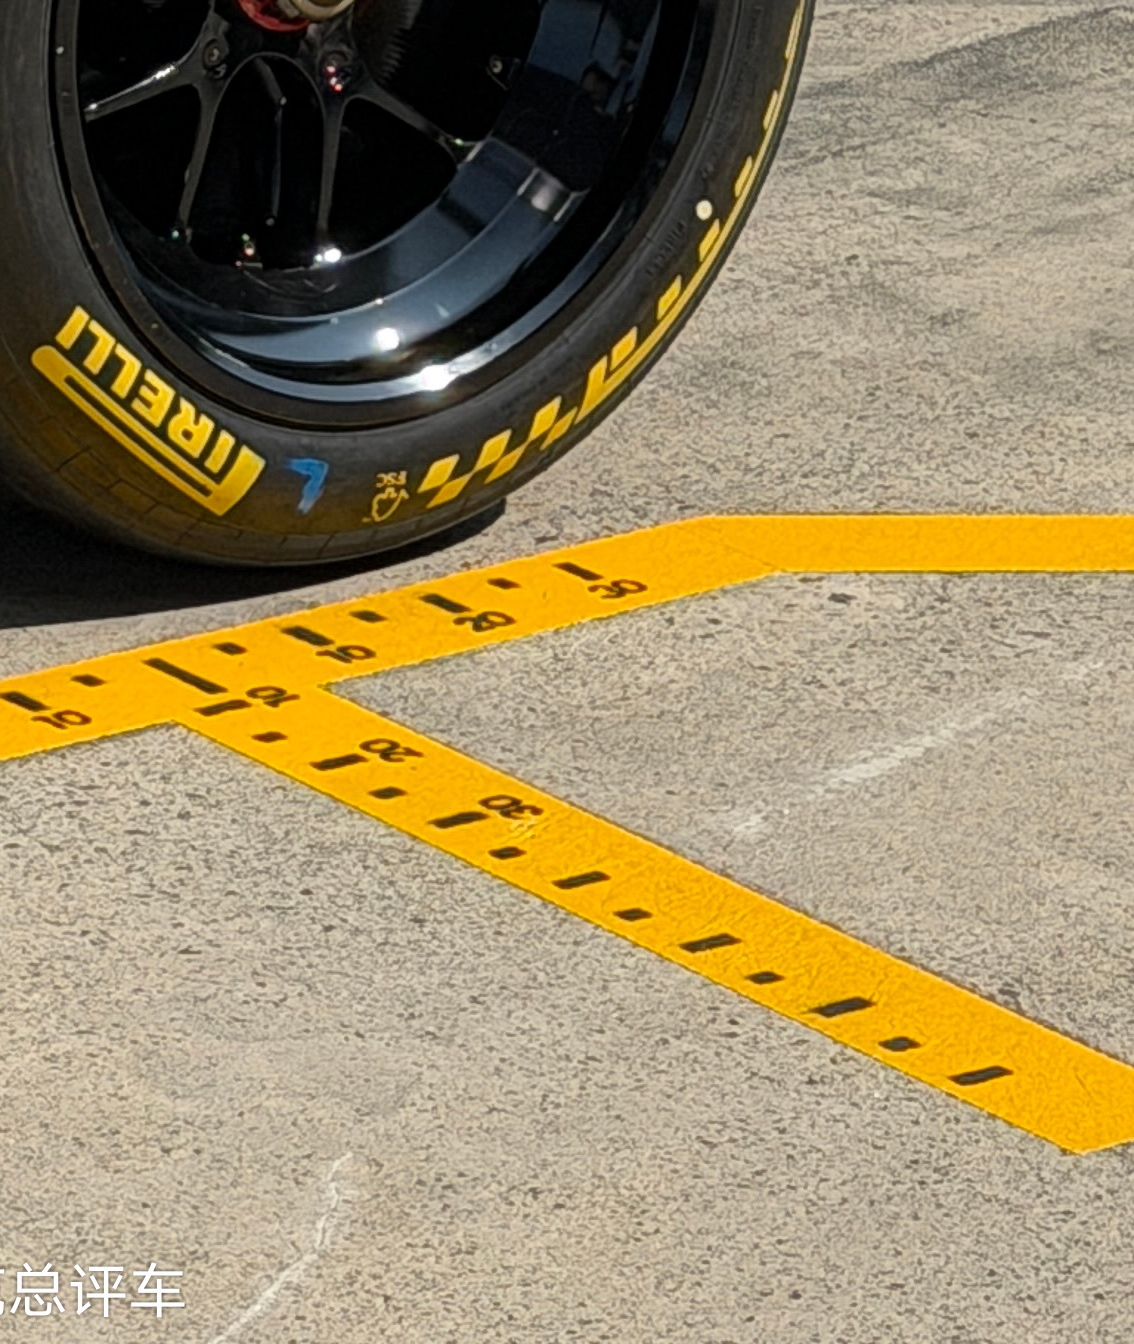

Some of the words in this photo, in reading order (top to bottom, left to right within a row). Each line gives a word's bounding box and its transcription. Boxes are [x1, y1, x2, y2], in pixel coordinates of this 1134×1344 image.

[30, 305, 265, 516] PIRELLI
[374, 470, 408, 488] FSC
[315, 644, 376, 664] 10
[452, 610, 517, 633] 20
[587, 578, 648, 600] 30
[32, 709, 93, 731] 10
[245, 685, 300, 709] 10
[359, 737, 424, 763] 20
[478, 793, 543, 820] 30
